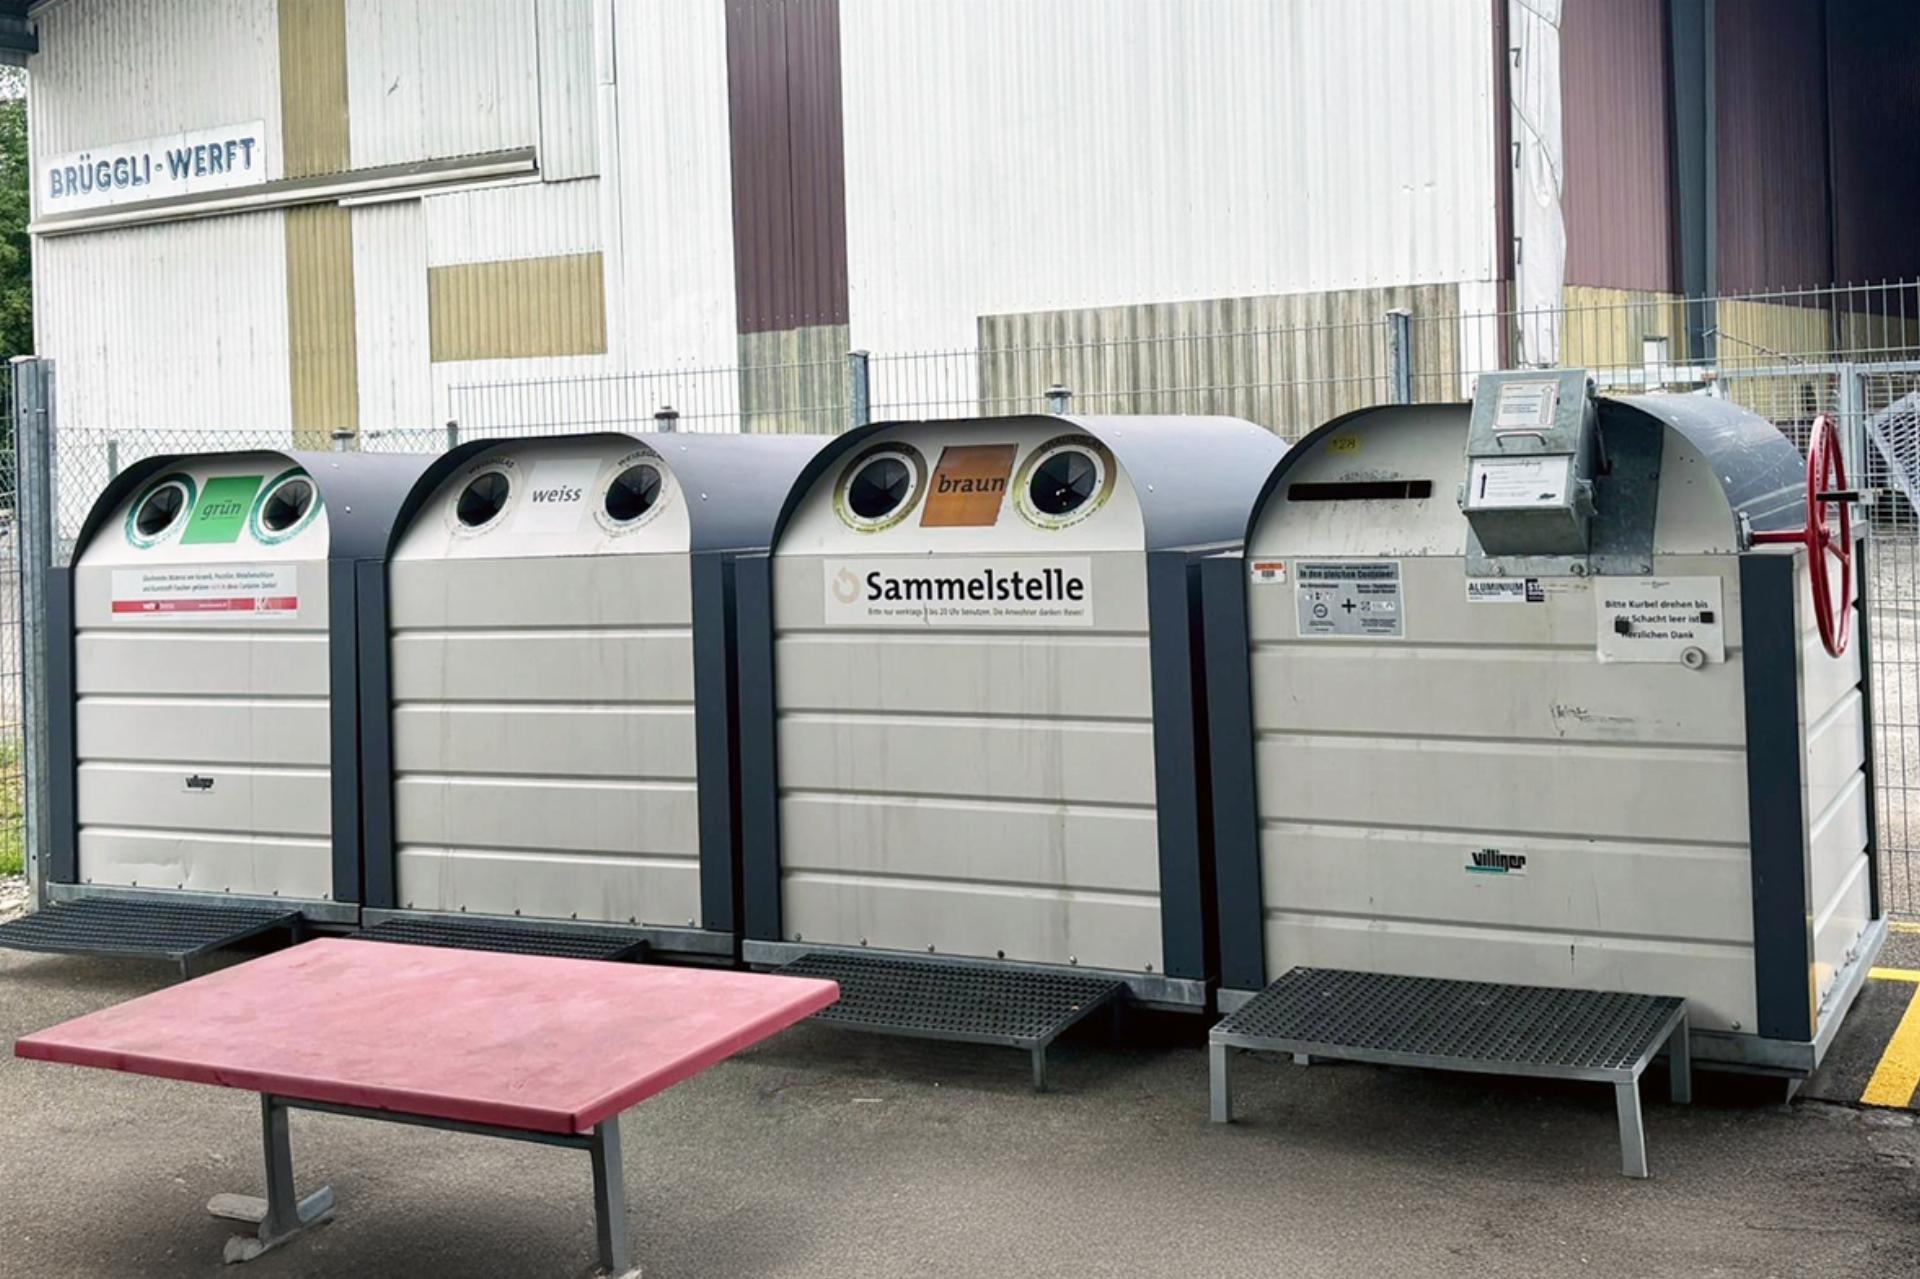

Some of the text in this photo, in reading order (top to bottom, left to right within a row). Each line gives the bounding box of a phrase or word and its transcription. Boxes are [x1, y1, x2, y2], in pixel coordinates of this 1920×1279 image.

[937, 475, 1007, 494] braun
[532, 485, 582, 503] weiss
[201, 499, 242, 521] grün
[866, 568, 1084, 601] Sammelstelle
[1468, 582, 1523, 592] ALUMINIUM
[1605, 600, 1709, 609] Bitte Kurbel drehen bis
[1631, 614, 1667, 624] Schacht
[1668, 615, 1687, 623] leer
[1670, 630, 1694, 639] Dank
